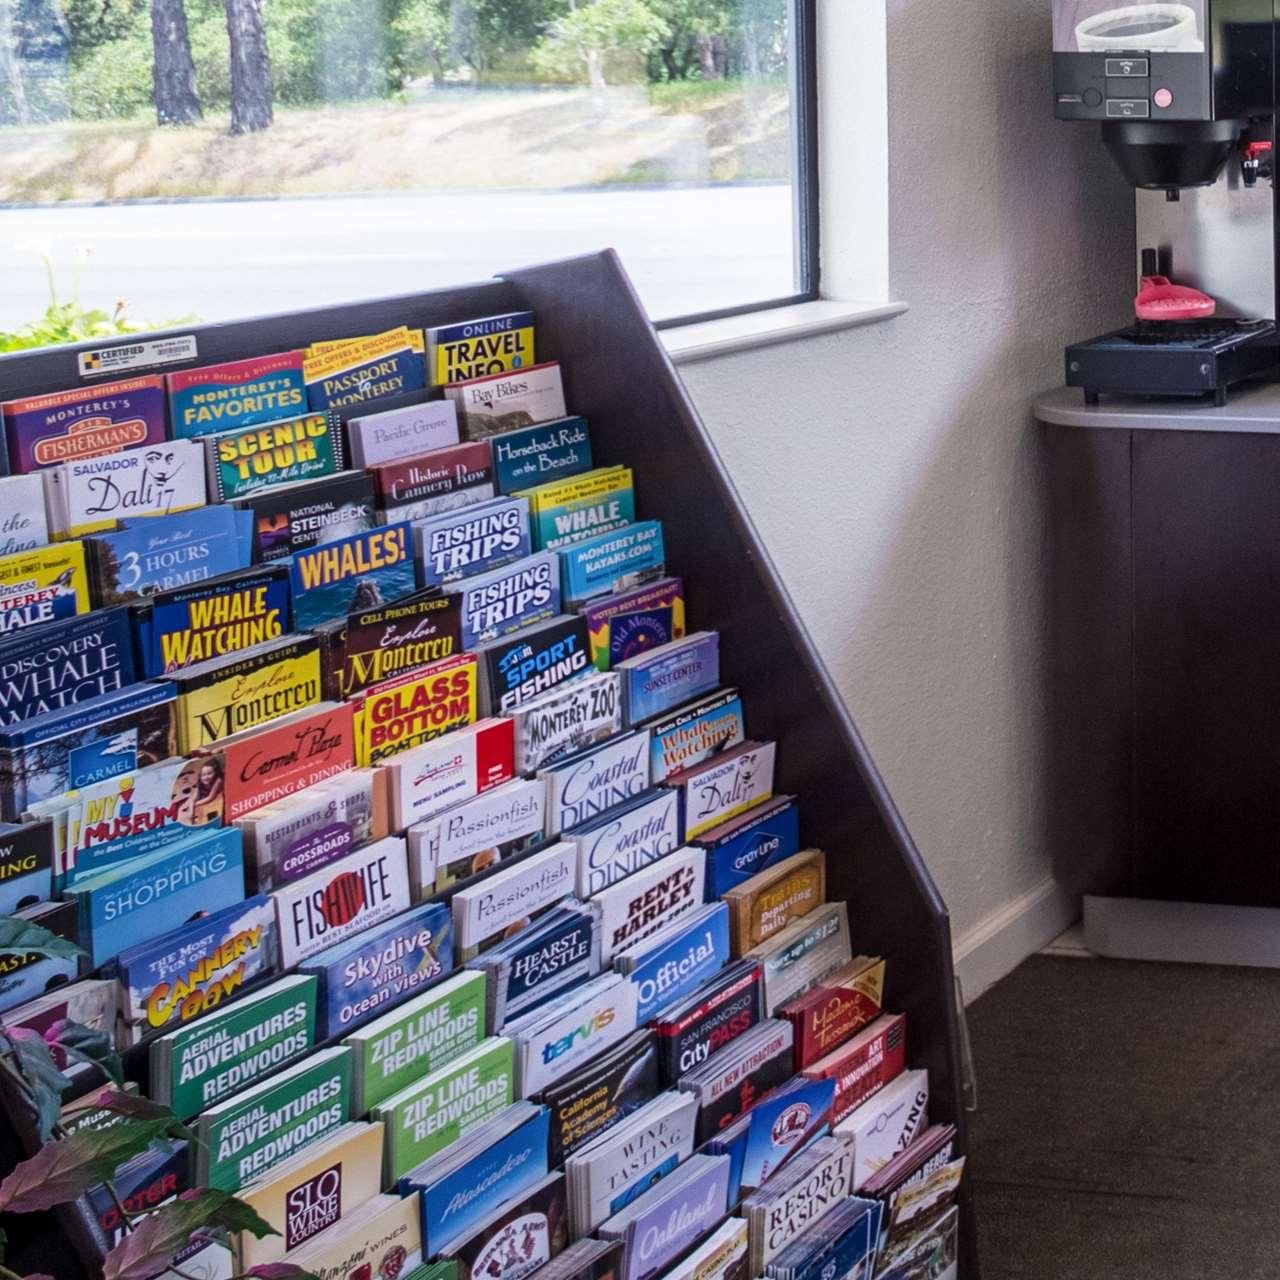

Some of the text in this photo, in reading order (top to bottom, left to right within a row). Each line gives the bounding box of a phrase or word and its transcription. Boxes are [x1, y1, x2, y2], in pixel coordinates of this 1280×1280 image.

[445, 332, 525, 366] TRAVEL
[463, 318, 513, 338] ONLINE
[101, 346, 145, 360] CERTIFIED
[192, 377, 292, 405] MONTEREY'S
[323, 358, 399, 396] PASSPORT
[328, 376, 404, 408] MONTEREY
[496, 379, 529, 399] Bikes
[46, 399, 131, 425] MONTEREY'S
[184, 388, 303, 425] FAVORITES
[42, 424, 142, 460] FISHERMAN'S
[218, 415, 328, 463] SCENIC
[374, 419, 448, 444] Pacific Grove
[498, 429, 586, 462] Horseback Ride
[73, 458, 138, 477] SALVADOR
[234, 440, 317, 480] TOUR
[392, 465, 486, 501] Cannery Row
[409, 466, 450, 484] Historic
[539, 453, 579, 472] Beach
[289, 502, 335, 519] NATIONAL
[291, 505, 367, 534] STEINBECK
[431, 508, 519, 552] FISHING
[554, 501, 621, 535] WHALE
[118, 542, 210, 588] 3 HOURS
[299, 528, 406, 590] WHALES!
[431, 529, 521, 575] TRIPS
[578, 536, 635, 562] MONTEREY
[190, 586, 269, 629] WHALE
[468, 564, 550, 612] FISHING
[468, 582, 551, 634] TRIPS
[360, 598, 450, 626] CELL PHONE TOURS
[2, 630, 104, 680] DISCOVERY
[161, 608, 282, 673] WATCHING
[506, 634, 577, 689] SPORT
[0, 643, 120, 708] WHALE
[372, 670, 469, 725] GLASS
[500, 649, 587, 712] FISHING
[370, 696, 469, 748] BOTTOM
[530, 683, 616, 753] MONTEREY ZOO
[663, 724, 738, 766] Watching
[74, 759, 132, 789] CARMEL
[231, 782, 294, 816] SHOPPING
[309, 760, 353, 785] DINING
[561, 741, 646, 806] Coastal
[84, 803, 179, 848] MUSEUM
[87, 792, 119, 825] MY
[265, 810, 321, 845] RESTAURANTS
[324, 800, 338, 818] &
[448, 795, 539, 841] Passionfish
[561, 775, 645, 832] DINING
[284, 832, 350, 871] CROSSROADS
[589, 800, 674, 870] Coastal
[105, 853, 227, 921] SHOPPING
[588, 832, 673, 896] DINING
[292, 856, 391, 947] FISHWIFE
[478, 860, 570, 920] Passionfish
[611, 876, 695, 948] HARLEY
[627, 866, 685, 919] RENT
[147, 923, 265, 1028] CANNERY
[150, 934, 215, 972] THE MOST
[344, 929, 433, 988] Skydive
[515, 929, 582, 980] HEARST
[524, 939, 589, 988] CASTLE
[637, 931, 716, 1005] Official
[340, 961, 442, 1024] Ocean views
[372, 965, 404, 988] with
[180, 1002, 307, 1086] ADVENTURES
[181, 1029, 231, 1064] AERIAL
[371, 1001, 451, 1065] ZIP LINE
[383, 1007, 478, 1078] REDWOODS
[203, 1029, 307, 1102] REDWOODS
[711, 1079, 723, 1097] ALL
[217, 1075, 342, 1163] ADVENTURES
[402, 1066, 480, 1130] ZIP LINE
[414, 1073, 508, 1143] REDWOODS
[560, 1086, 608, 1120] California
[220, 1104, 268, 1143] AERIAL
[239, 1103, 343, 1179] REDWOODS
[624, 1121, 669, 1159] WINE
[607, 1129, 683, 1190] TASTING
[288, 1169, 340, 1221] SLO
[769, 1150, 852, 1232] RESORT
[769, 1176, 846, 1251] CASINO
[289, 1194, 338, 1235] WINE
[289, 1211, 337, 1246] COUNTRY
[639, 1181, 717, 1261] Oakland
